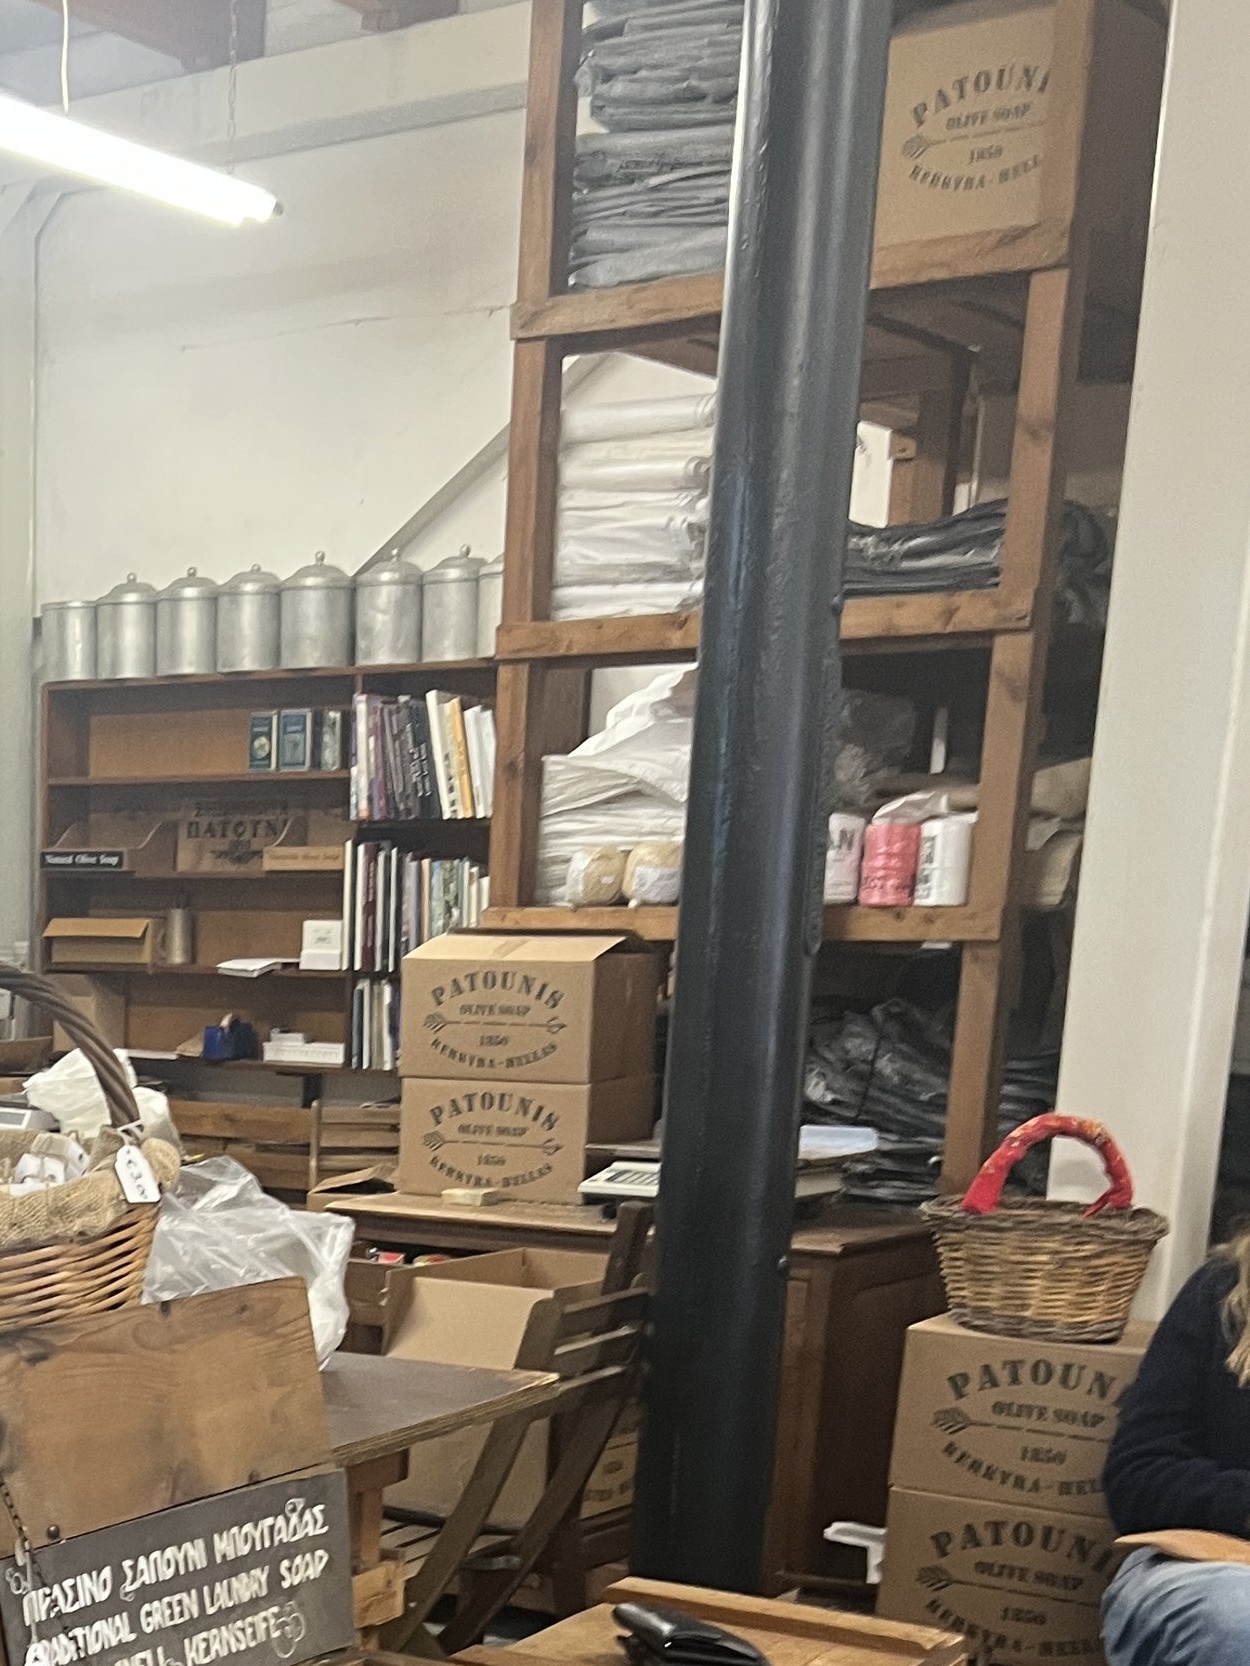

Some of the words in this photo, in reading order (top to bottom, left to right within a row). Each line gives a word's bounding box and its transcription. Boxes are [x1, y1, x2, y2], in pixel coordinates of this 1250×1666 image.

[910, 64, 1050, 129] PATOUNI
[431, 970, 565, 1010] PATOUNIS
[429, 1091, 560, 1132] PATOUNIS
[947, 1358, 1117, 1401] PATOUN
[930, 1520, 1115, 1575] PATOUNI
[139, 1587, 200, 1635] GREEN
[203, 1564, 270, 1616] LAUNDRY
[279, 1549, 329, 1590] SOAP
